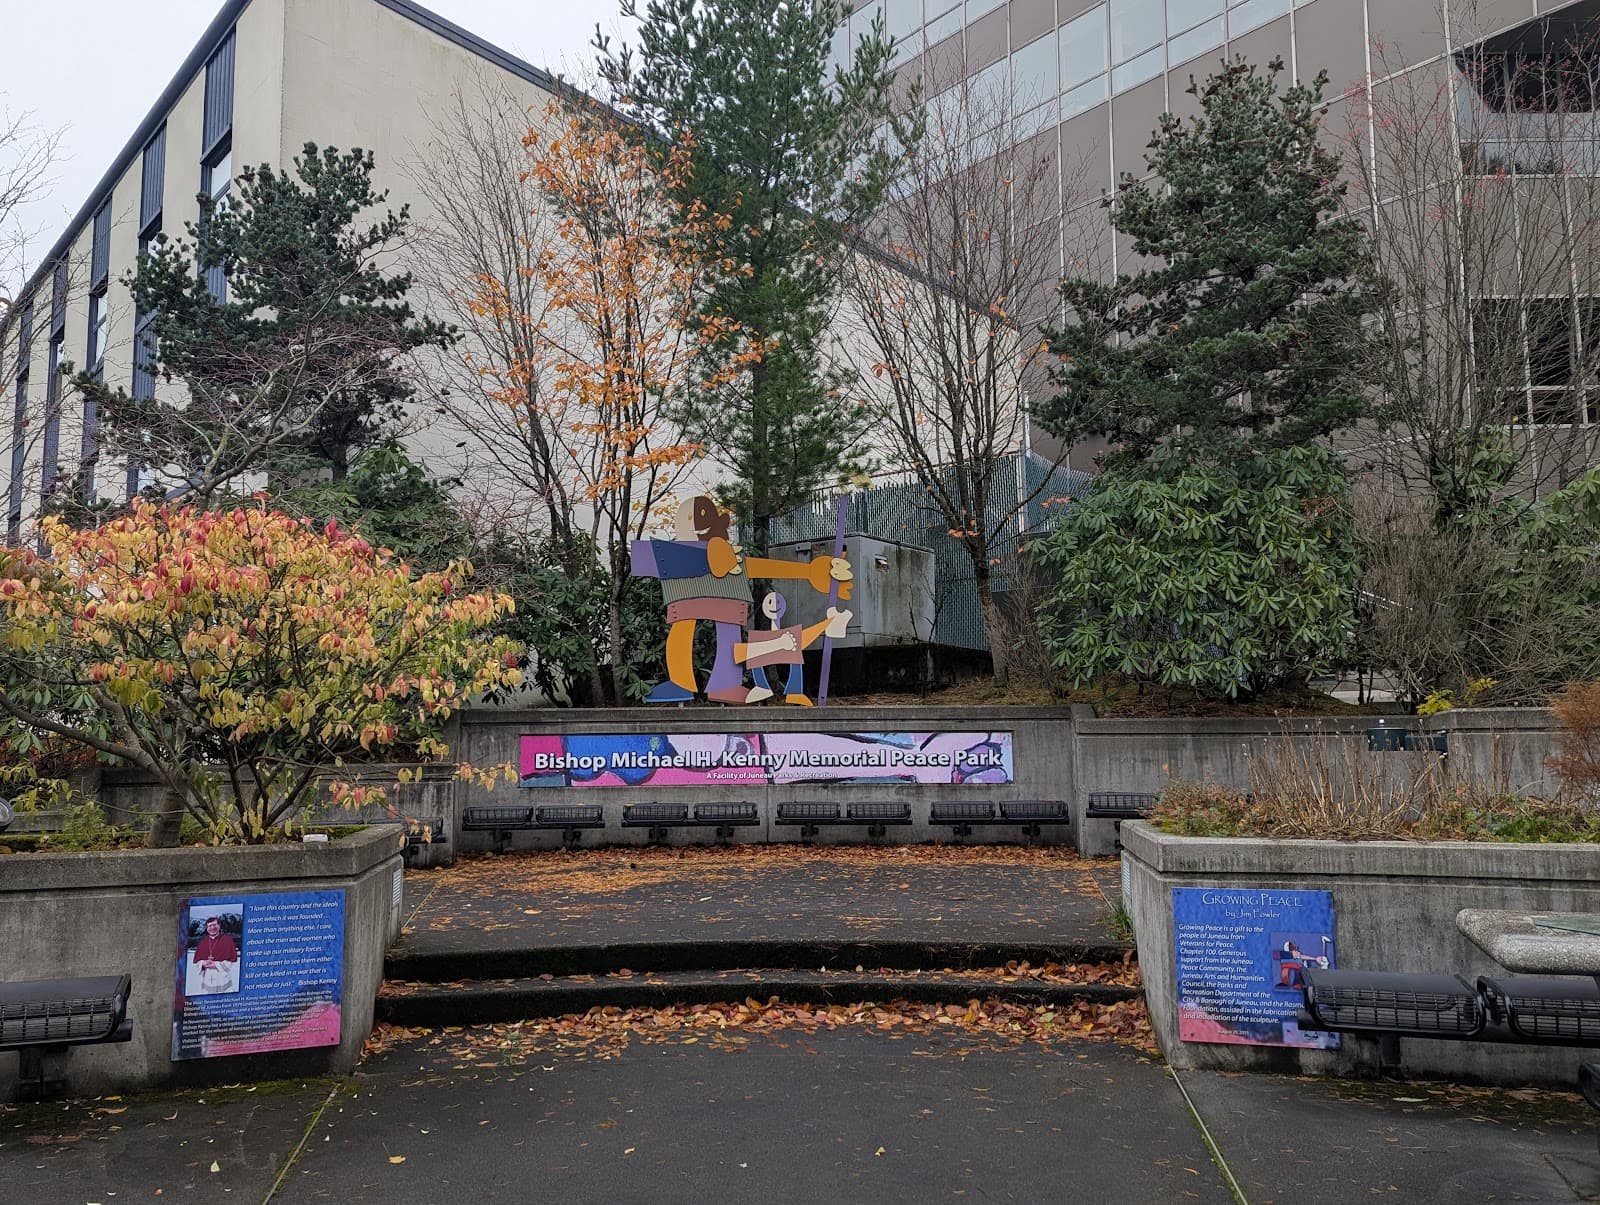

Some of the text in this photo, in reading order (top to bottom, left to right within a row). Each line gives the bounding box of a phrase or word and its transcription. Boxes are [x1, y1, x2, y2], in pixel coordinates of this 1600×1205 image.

[534, 750, 1002, 772] Bishop Michael H. Kenny Memorial Peace Park
[713, 772, 738, 780] Facility
[322, 900, 338, 908] ideals
[1202, 891, 1303, 907] GROWING PEACE
[1225, 908, 1281, 919] by Jim Fowler
[278, 924, 304, 932] anything
[1234, 926, 1245, 934] gift
[282, 946, 304, 954] military
[1230, 974, 1265, 982] Humanities
[1182, 988, 1214, 996] Recreation
[1215, 990, 1252, 998] Department
[1183, 996, 1194, 1004] City
[1200, 998, 1227, 1006] Borough
[1220, 1006, 1244, 1014] assisted
[1263, 1008, 1297, 1016] fabrication
[1196, 1013, 1231, 1021] installation
[1231, 1014, 1239, 1022] of
[1250, 1016, 1280, 1024] sculpture.
